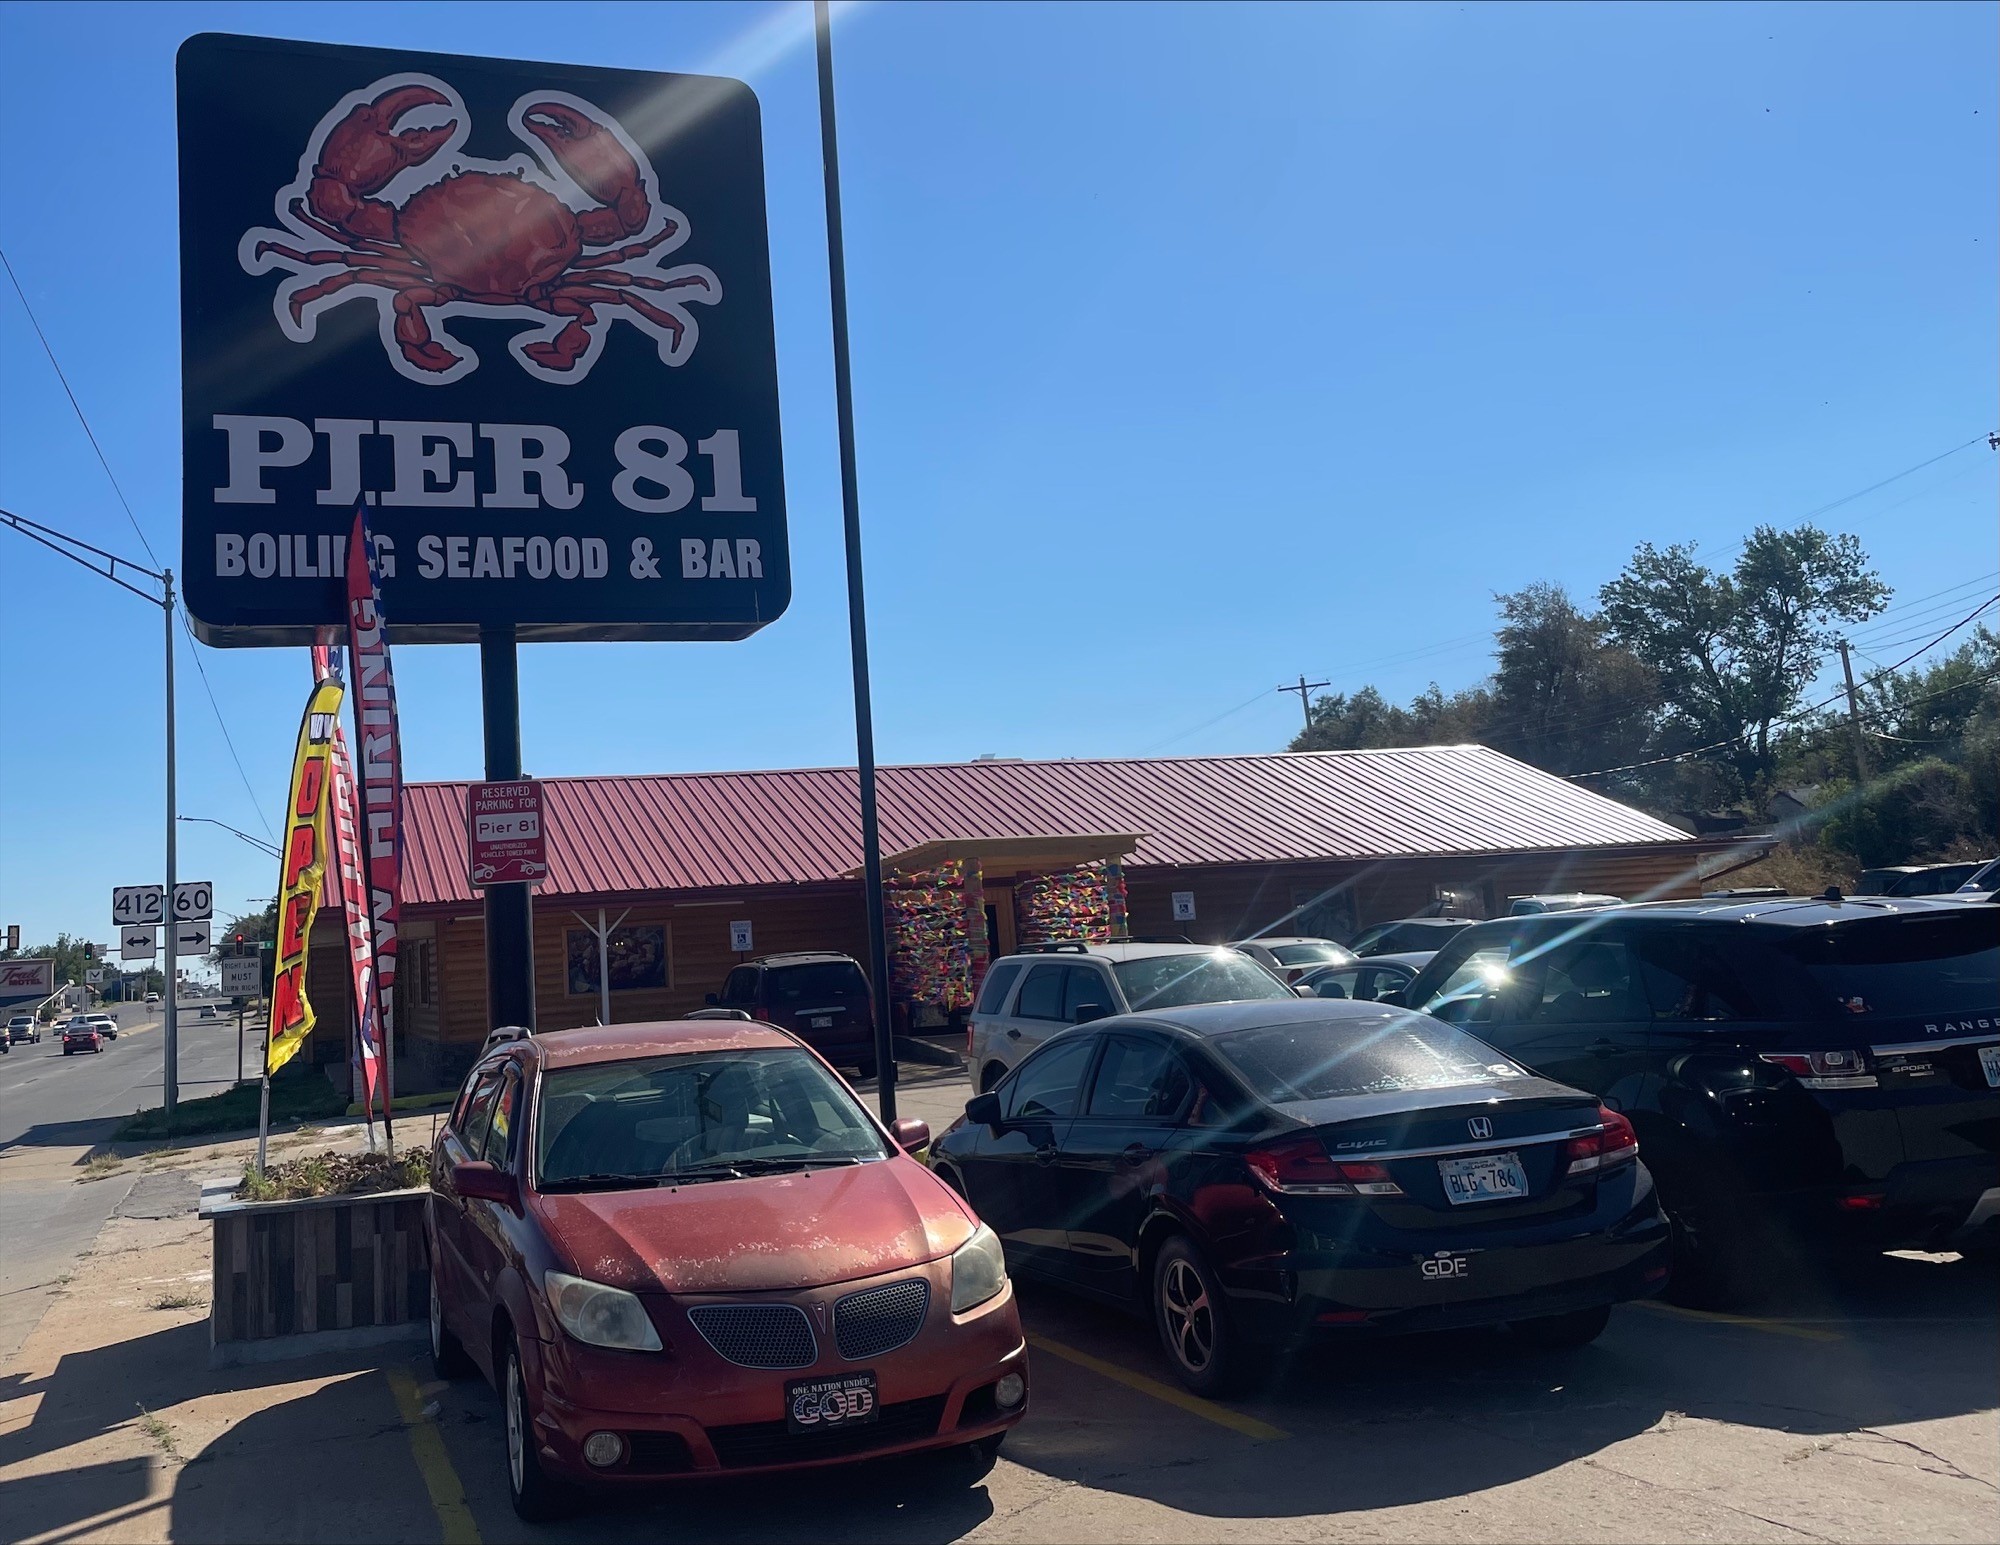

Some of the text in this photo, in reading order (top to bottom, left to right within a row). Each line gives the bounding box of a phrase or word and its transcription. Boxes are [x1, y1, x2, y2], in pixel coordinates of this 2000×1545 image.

[212, 413, 758, 513] PIER 81
[416, 535, 609, 579] SEAFOOD
[629, 537, 662, 579] &
[680, 538, 764, 579] BAR
[481, 786, 530, 799] RESERVED
[475, 798, 537, 811] PARKING FOR
[479, 820, 537, 835] Pier 81
[480, 850, 506, 859] VEHICLES
[115, 892, 159, 915] 412
[176, 889, 209, 912] 60
[272, 755, 324, 1043] OPEN
[224, 961, 259, 970] RIGHT LANE
[231, 972, 252, 981] MUST
[241, 983, 259, 991] RIGHT
[1891, 1063, 1933, 1073] SPORT
[1336, 1139, 1388, 1150] CIVIC
[1421, 1257, 1467, 1276] GDF
[792, 1377, 871, 1397] ONE NATION UNDER
[793, 1386, 874, 1425] GOD
